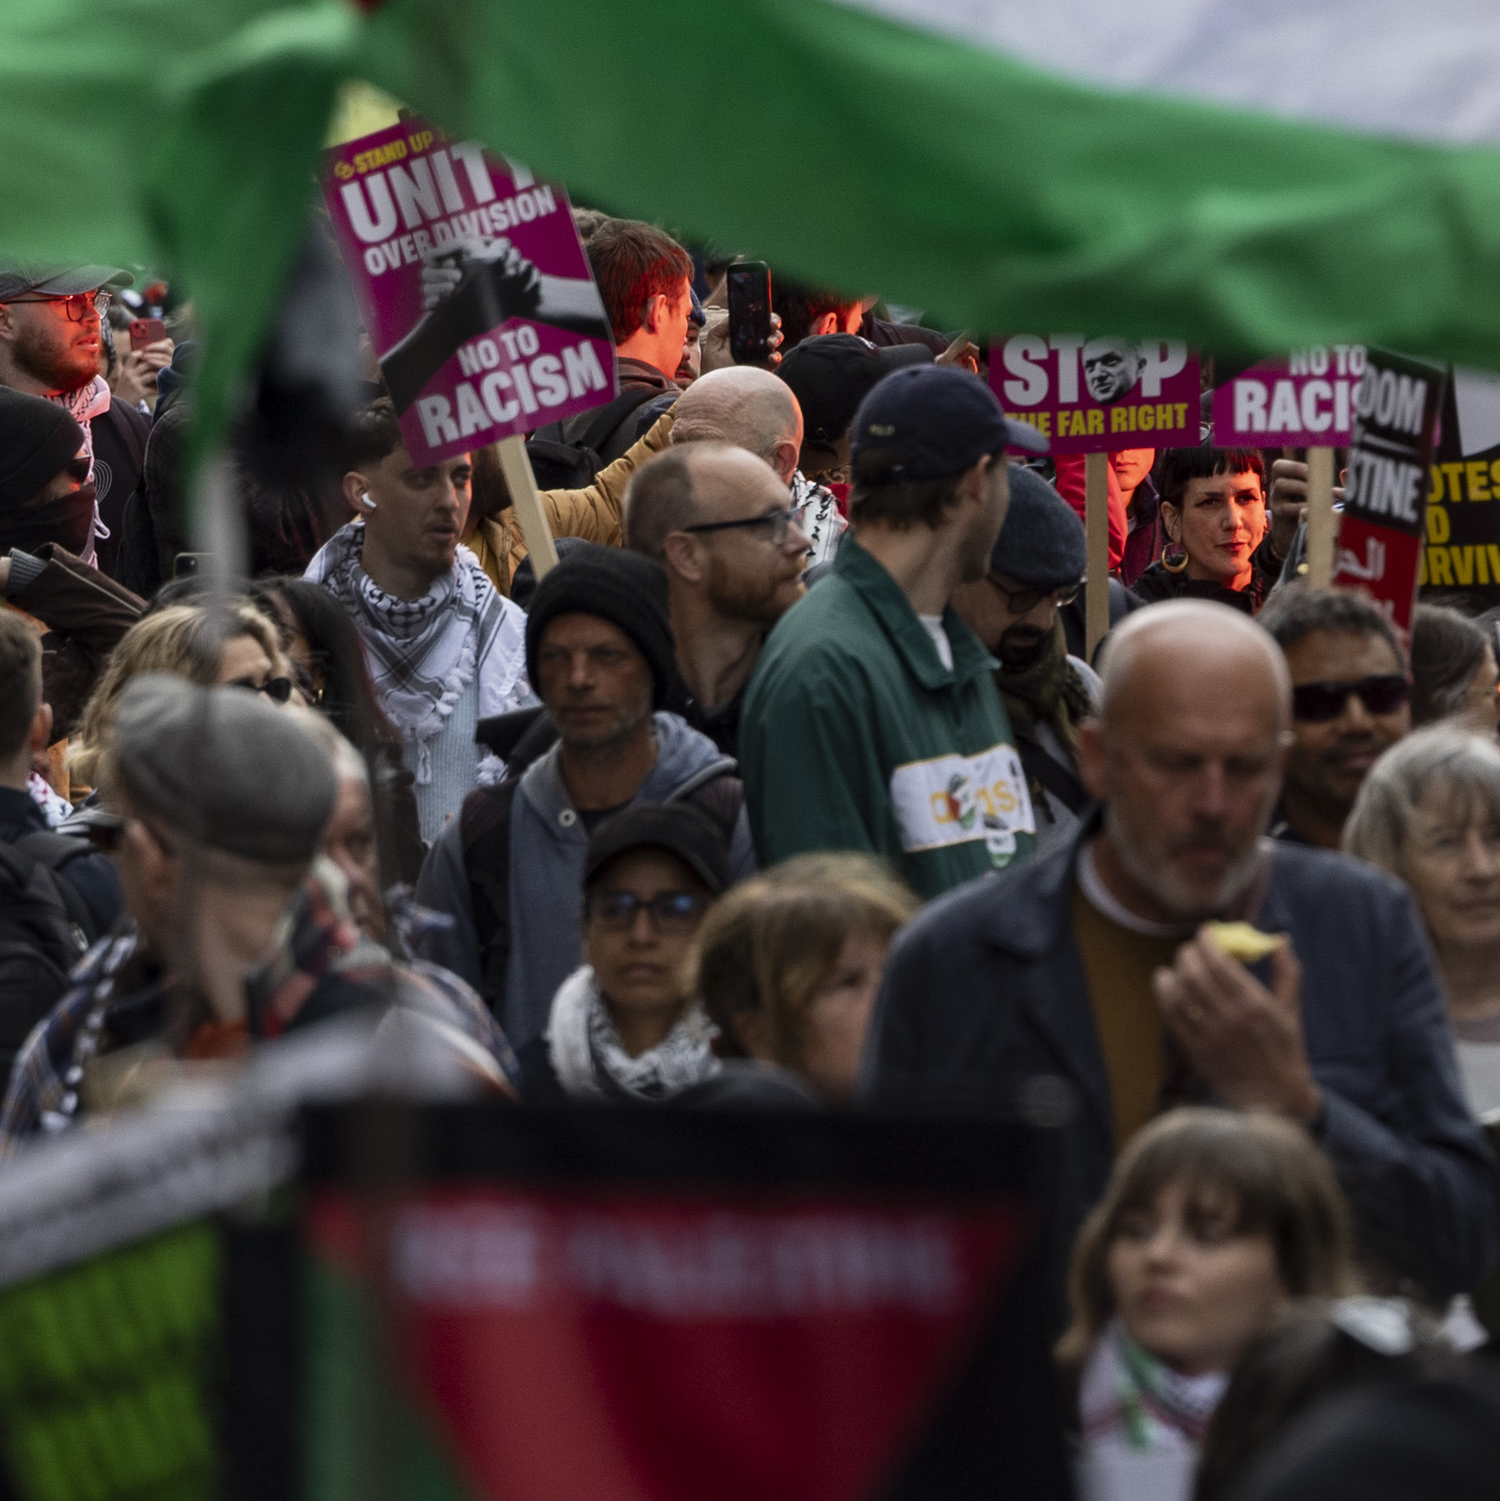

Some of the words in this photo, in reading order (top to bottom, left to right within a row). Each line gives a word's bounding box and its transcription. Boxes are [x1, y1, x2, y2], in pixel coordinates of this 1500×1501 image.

[353, 139, 408, 175] STAND
[409, 130, 434, 154] UP
[434, 186, 558, 254] DIVISION
[456, 338, 501, 378] NO
[500, 325, 541, 362] TO
[1337, 344, 1366, 376] TO
[416, 340, 608, 449] RACISM
[1056, 409, 1105, 437] FAR
[1111, 403, 1188, 433] RIGHT
